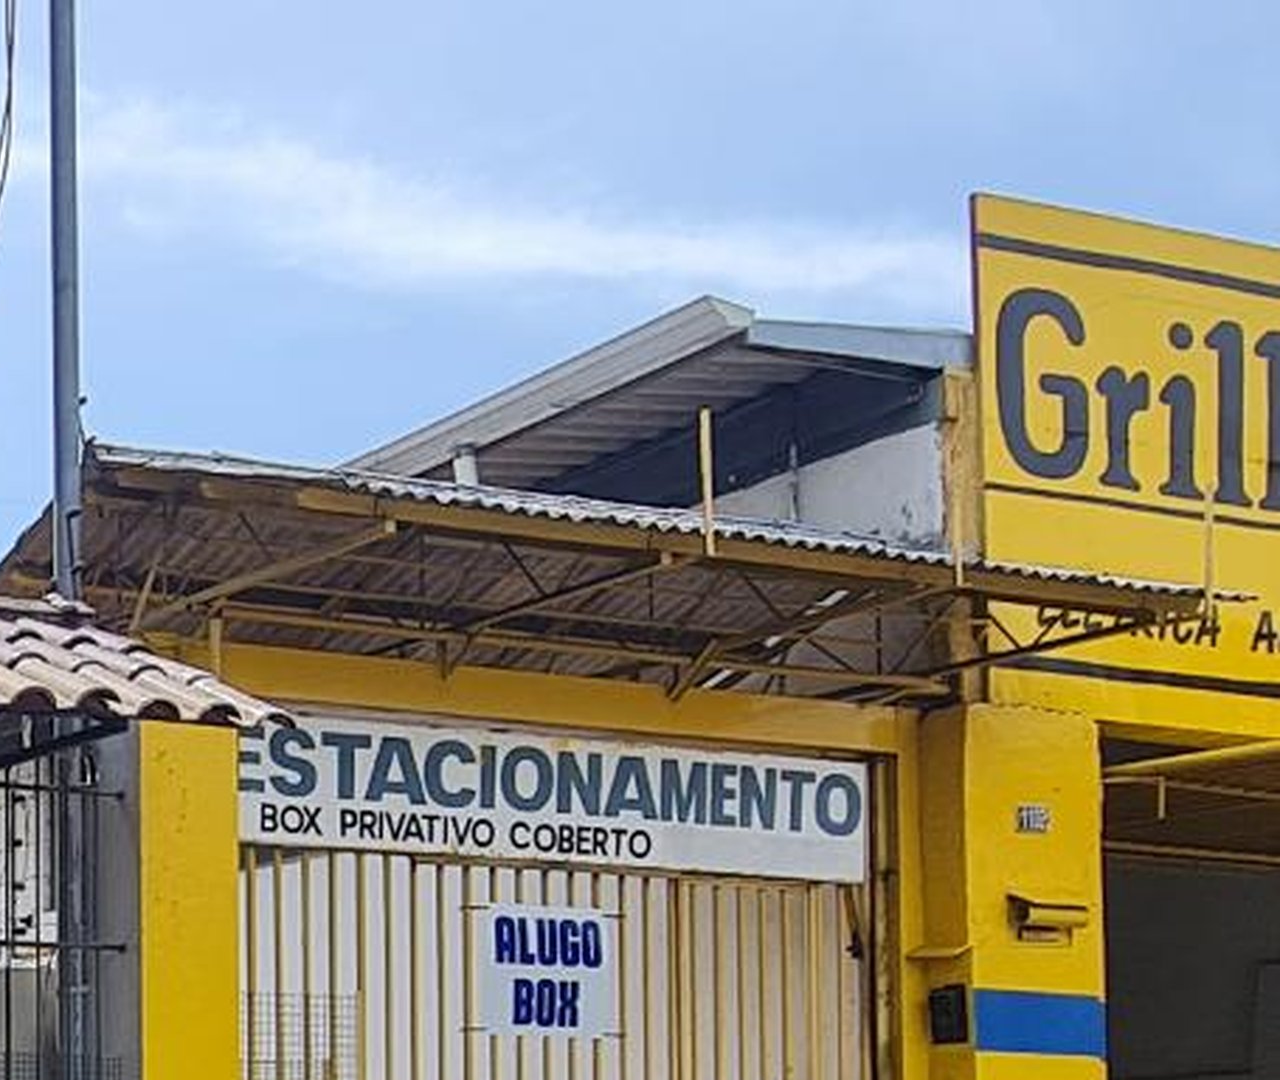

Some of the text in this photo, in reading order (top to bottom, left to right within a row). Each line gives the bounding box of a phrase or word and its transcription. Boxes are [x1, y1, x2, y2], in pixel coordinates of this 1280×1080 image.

[238, 724, 862, 838] ESTACIONAMENTO
[260, 803, 652, 859] BOX PRIVATIVO COBERTO
[494, 915, 603, 968] ALUGO
[512, 978, 580, 1028] BOX
